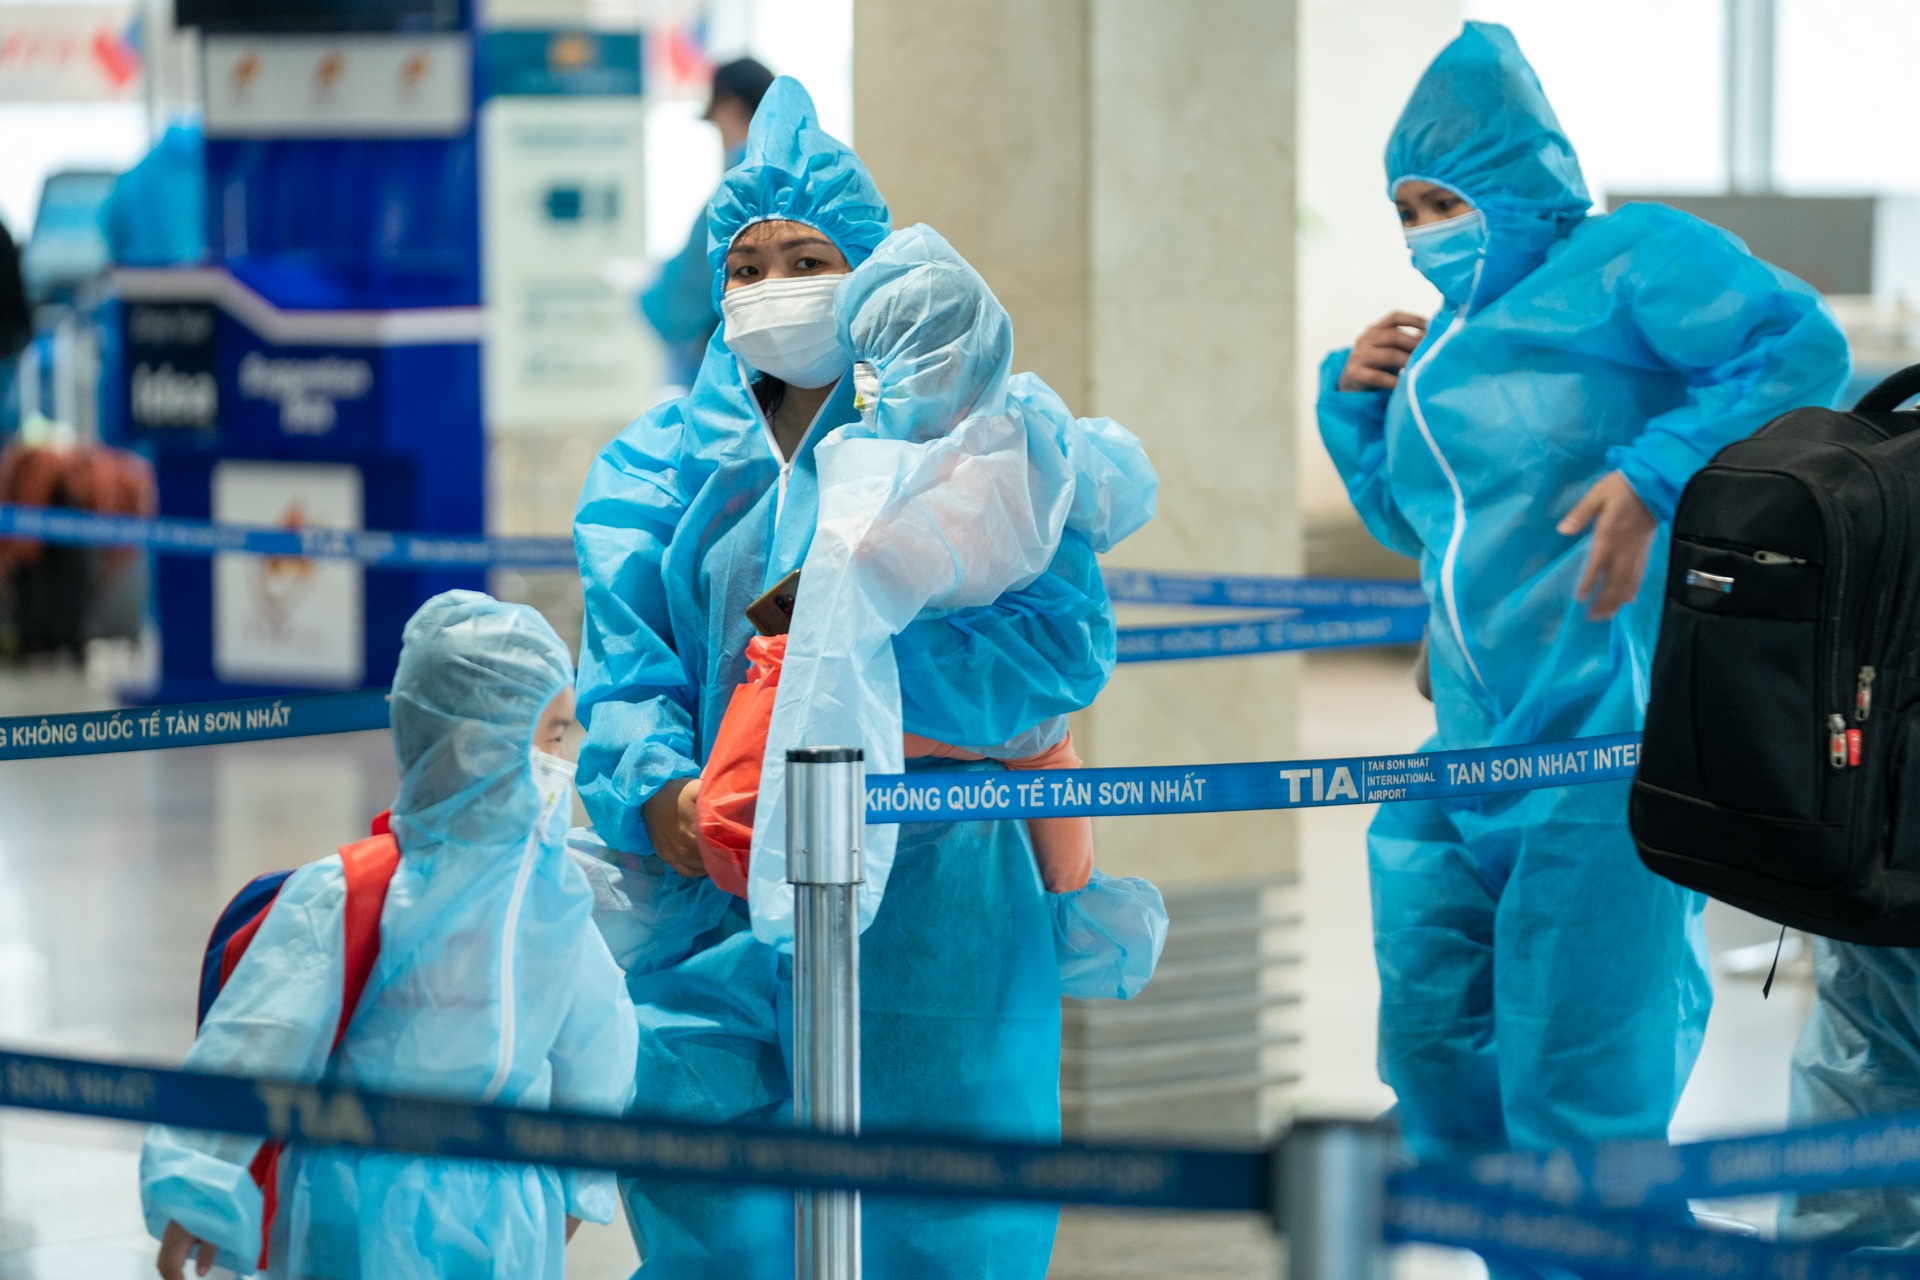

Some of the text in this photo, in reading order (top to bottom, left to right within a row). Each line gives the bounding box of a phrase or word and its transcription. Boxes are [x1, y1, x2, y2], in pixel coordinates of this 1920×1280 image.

[12, 718, 78, 747] KHÔNG
[82, 711, 134, 742] QUỐC
[139, 708, 161, 737] TẾ
[165, 709, 200, 736] TÂN
[204, 711, 242, 733] SƠN
[246, 699, 292, 729] NHẤT
[1367, 757, 1430, 772] TAN SON NHAT
[1367, 772, 1436, 787] INTERNATIONAL
[1447, 762, 1486, 787] TAN
[1490, 756, 1533, 782] SON
[1538, 750, 1589, 777] NHAT
[866, 771, 1207, 812] KHÔNG QUỐC TẾ TÂN SƠN NHẤT
[1279, 766, 1359, 804] TIA
[1368, 788, 1407, 801] AIRPORT
